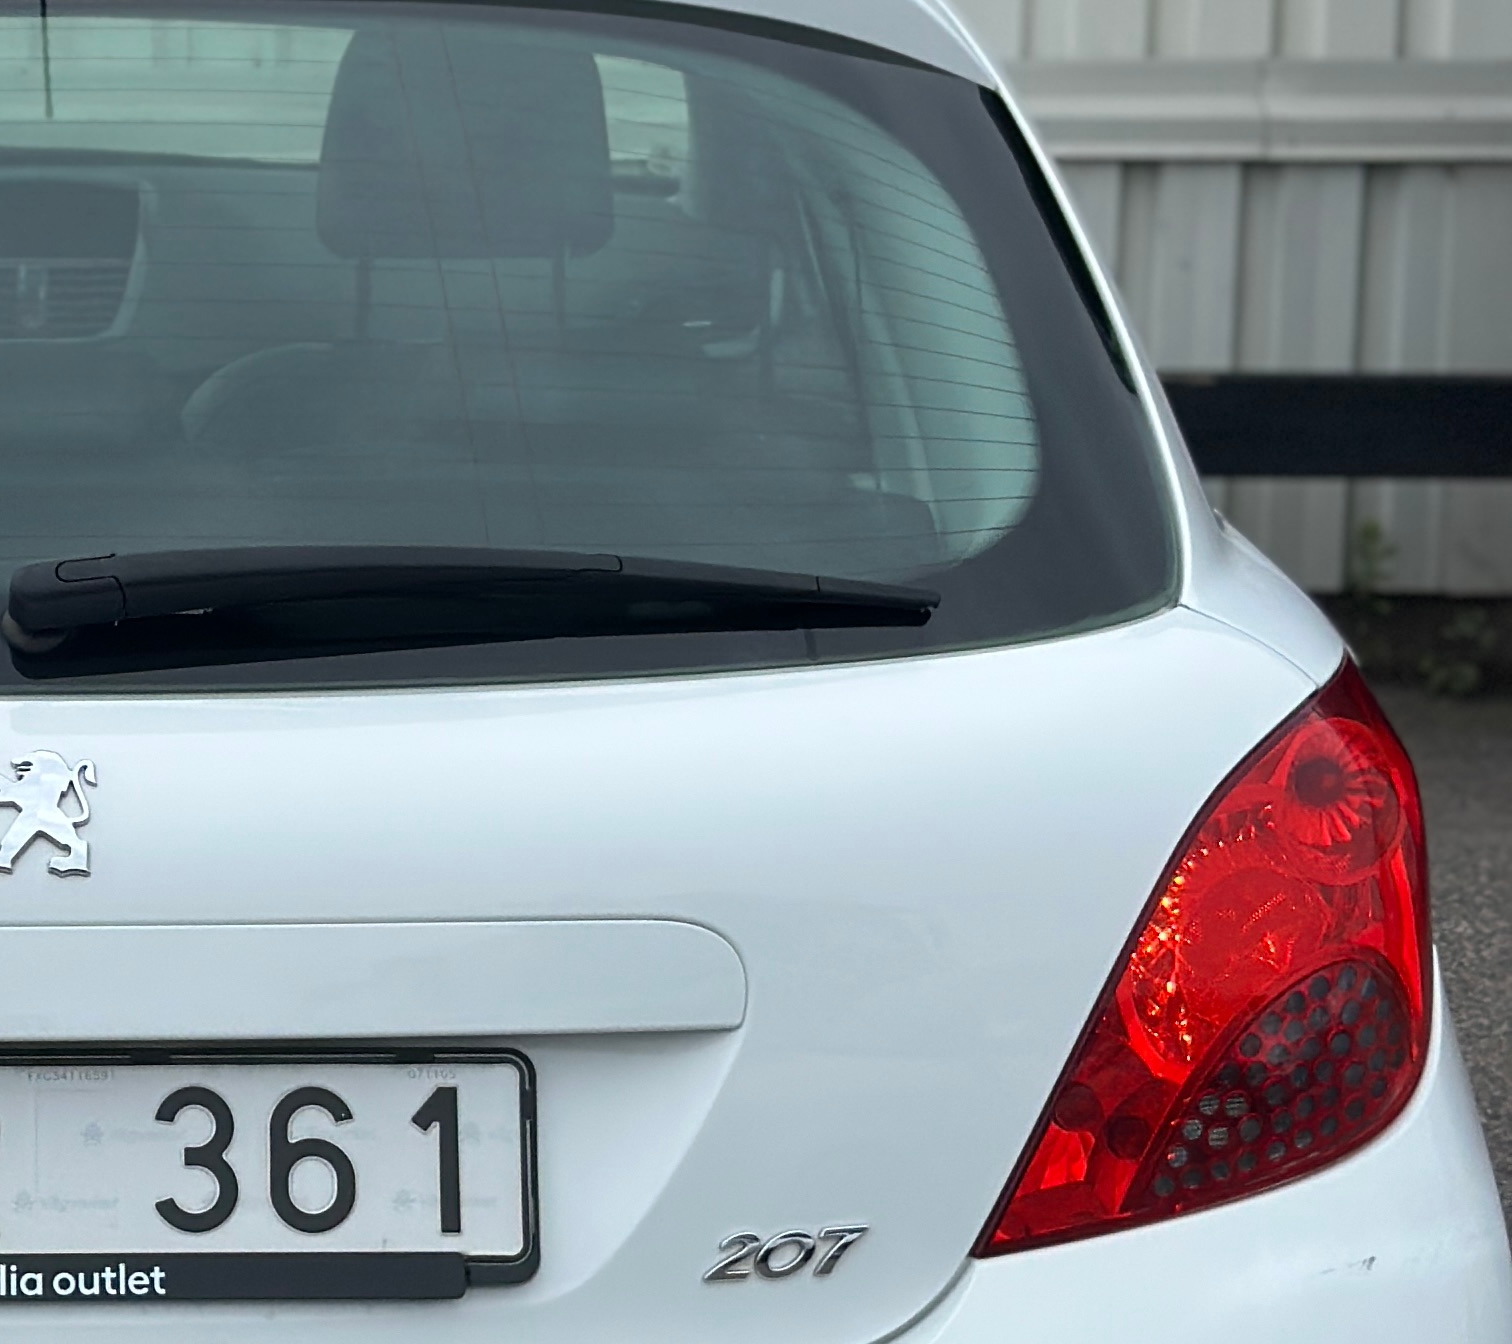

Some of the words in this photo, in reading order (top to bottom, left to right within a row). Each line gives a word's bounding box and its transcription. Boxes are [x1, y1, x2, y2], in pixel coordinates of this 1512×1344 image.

[153, 1084, 463, 1236] 361
[52, 1262, 167, 1296] outlet
[702, 1223, 870, 1282] 207
